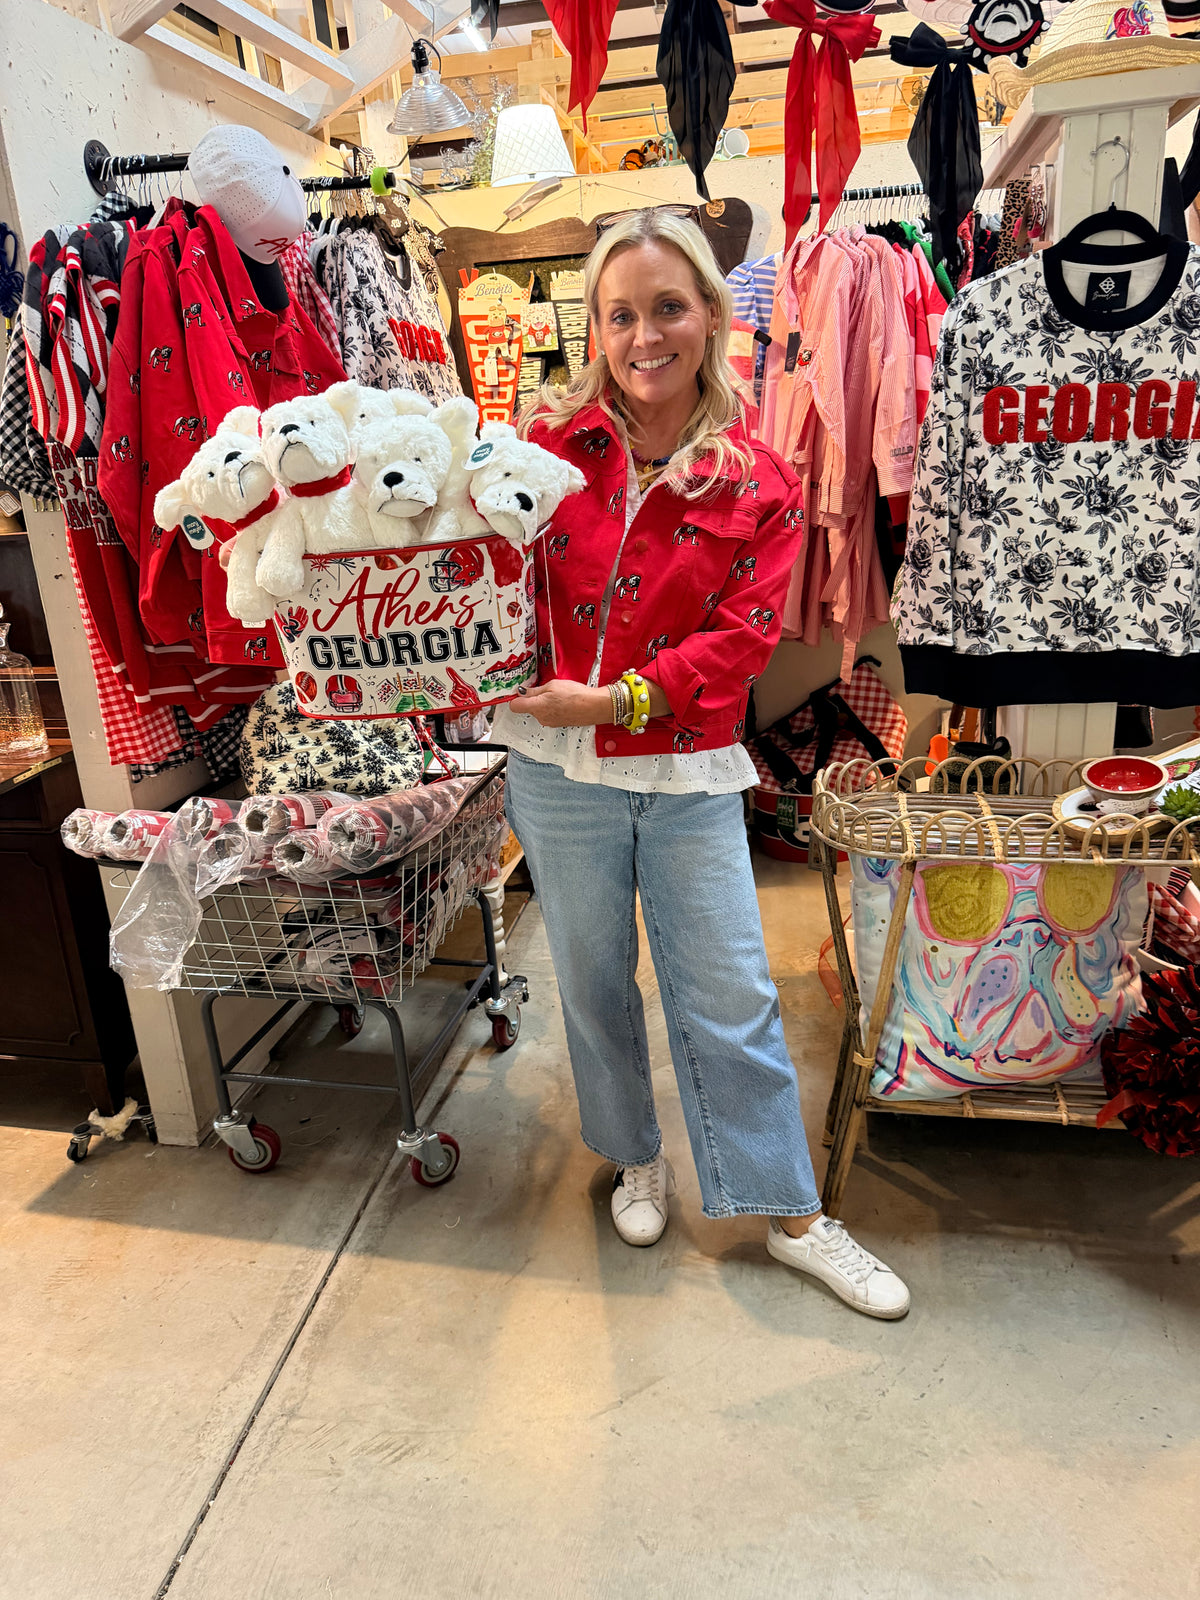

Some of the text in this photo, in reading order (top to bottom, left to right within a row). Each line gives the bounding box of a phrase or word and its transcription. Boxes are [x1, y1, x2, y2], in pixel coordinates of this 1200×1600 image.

[475, 283, 513, 297] Benoit's
[556, 303, 588, 379] ATHENS GEORGI
[312, 566, 484, 643] Athens
[306, 620, 502, 670] GEORGIA
